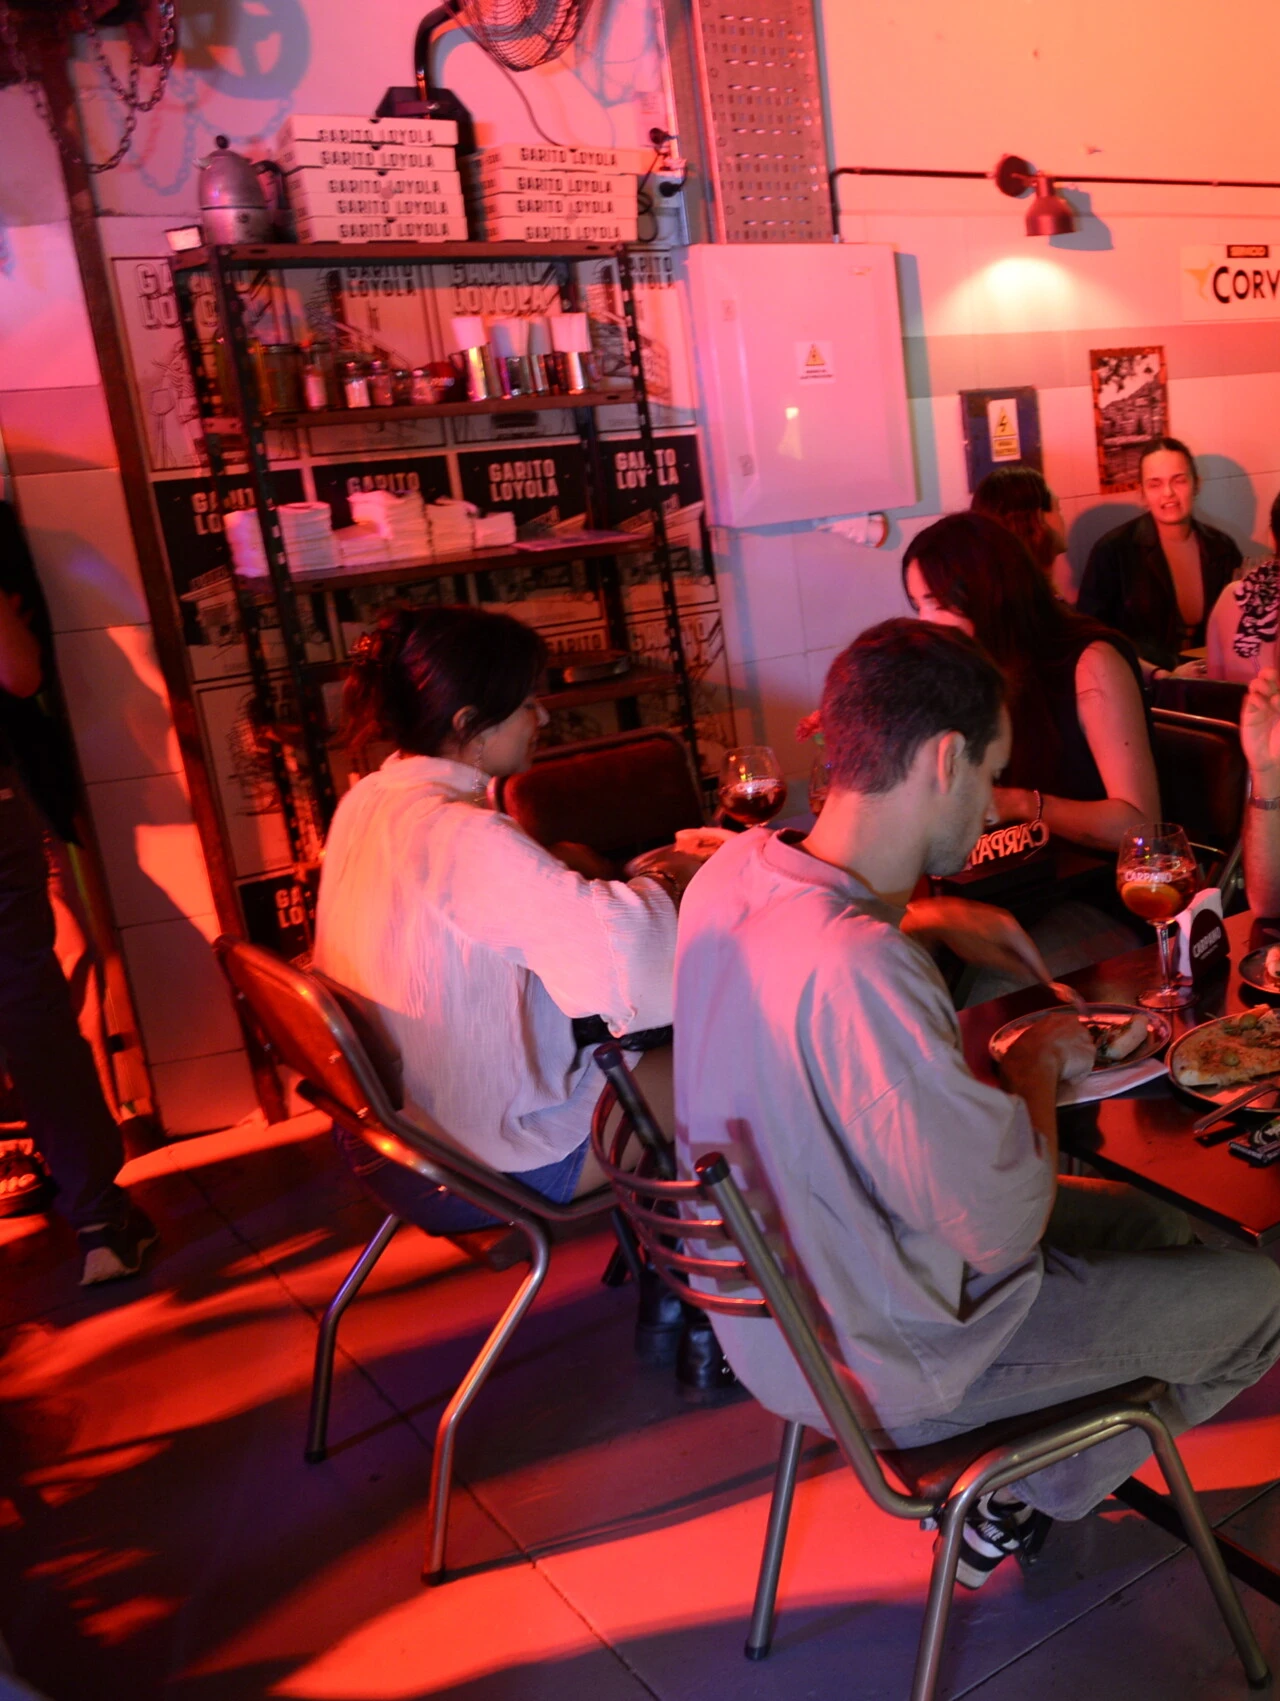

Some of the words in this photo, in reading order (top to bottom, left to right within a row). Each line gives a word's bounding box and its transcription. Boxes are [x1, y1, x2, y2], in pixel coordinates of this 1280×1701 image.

[318, 129, 373, 143] GARITO
[381, 129, 436, 144] LOYOLA
[321, 151, 375, 166] GARITO
[381, 153, 436, 168] LOYOLA
[520, 147, 567, 163] GARITO
[572, 151, 618, 166] LOYOLA
[328, 179, 382, 194] GARITO
[517, 176, 563, 192] GARITO
[568, 178, 613, 194] LOYOLA
[336, 199, 390, 214] GARITO
[396, 200, 449, 215] LOYOLA
[517, 199, 563, 213] GARITO
[569, 200, 614, 214] LOYOLA
[339, 222, 392, 238] GARITO
[398, 223, 450, 238] LOYOLA
[525, 225, 571, 240] GARITO
[576, 226, 621, 240] LOYOLA
[348, 280, 417, 298] LOYOLA
[453, 286, 548, 316] LOYOLA
[488, 458, 556, 483] GARITO
[616, 467, 680, 490] LOYLA
[490, 478, 559, 502] LOYOLA
